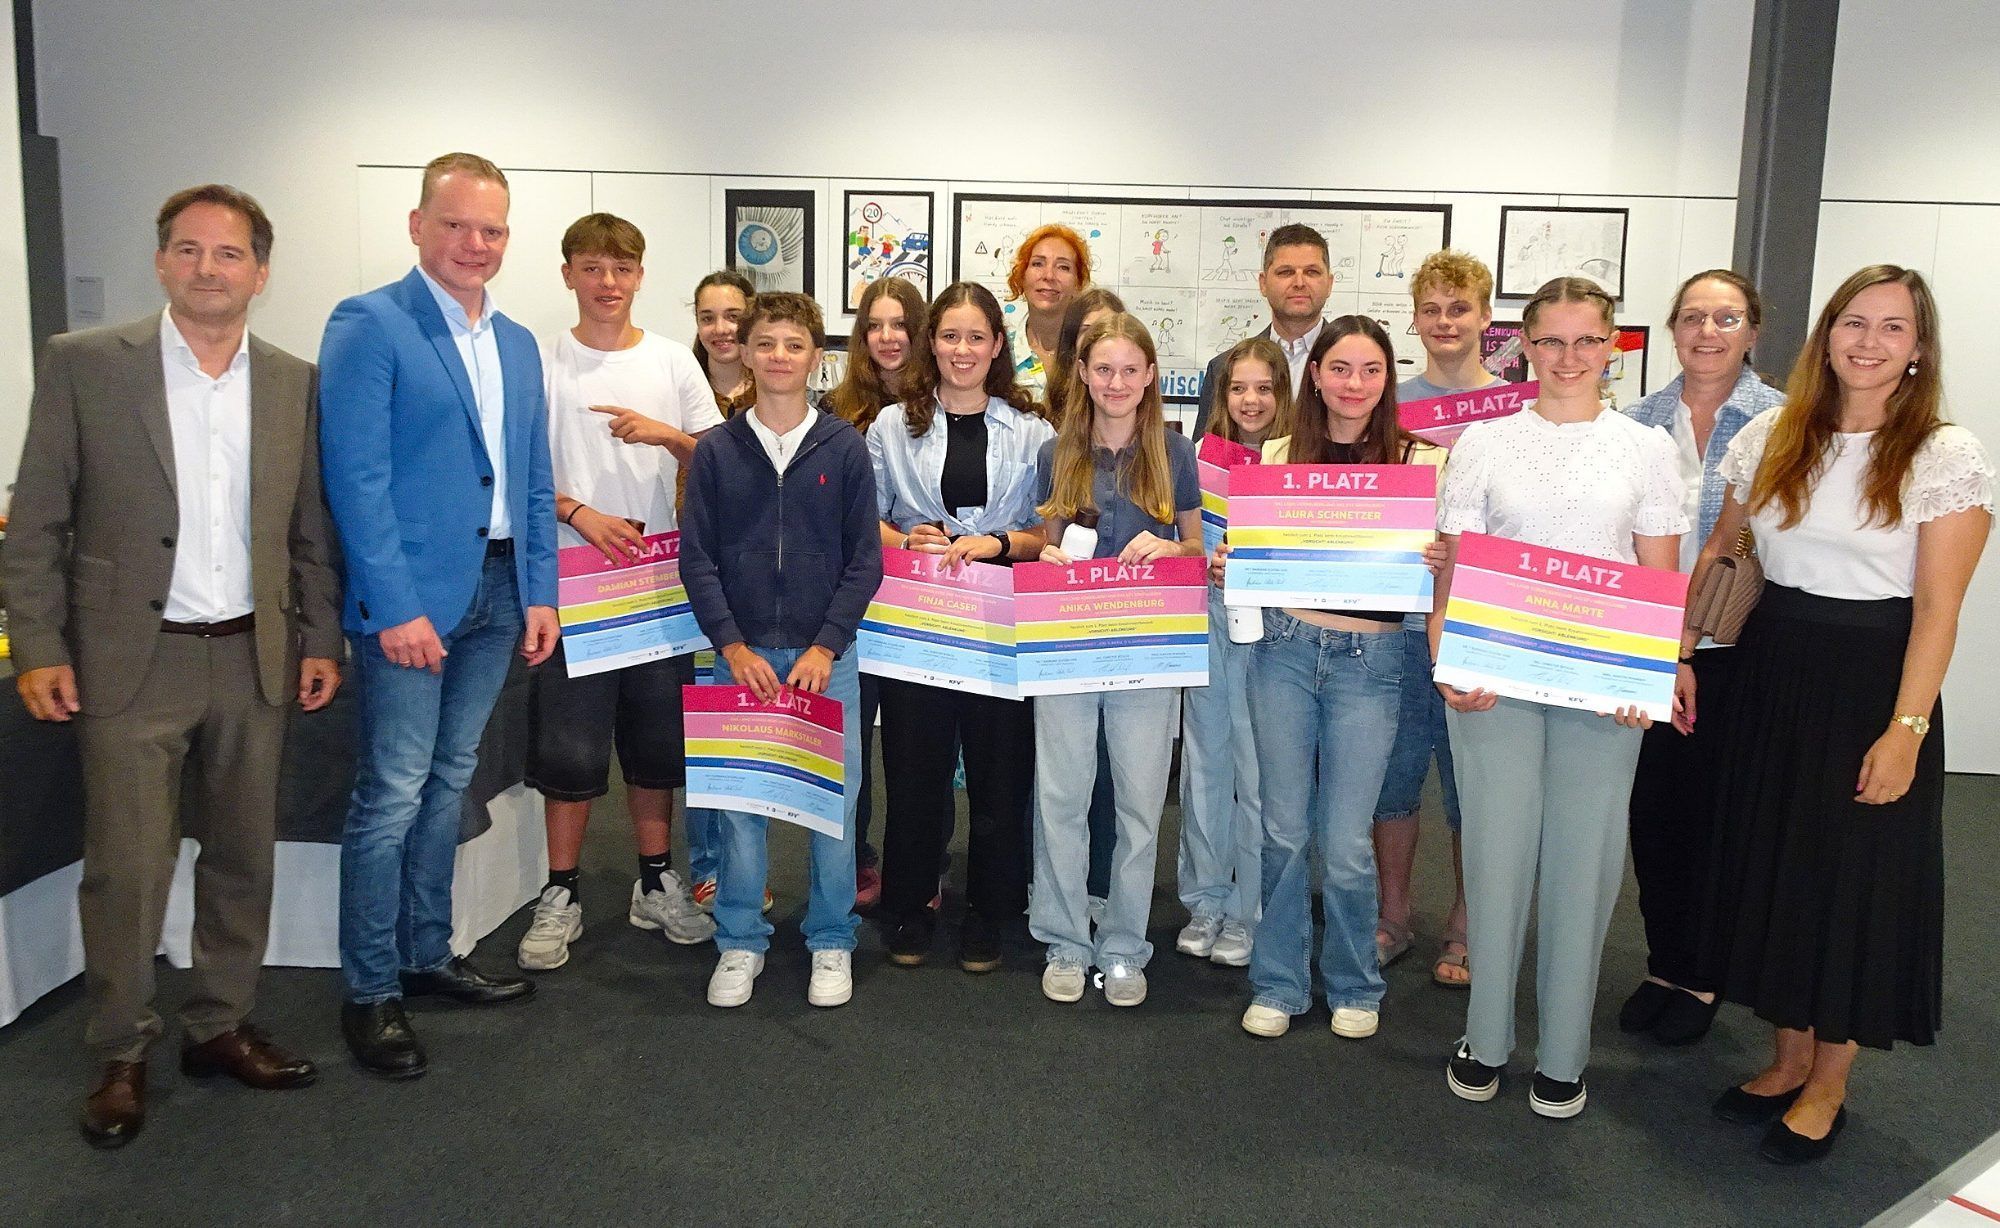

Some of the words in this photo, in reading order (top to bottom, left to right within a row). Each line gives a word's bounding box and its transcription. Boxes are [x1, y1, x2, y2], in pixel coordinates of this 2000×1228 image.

[866, 208, 879, 218] 20
[1433, 405, 1451, 421] 1.
[1456, 392, 1521, 417] PLATZ
[1283, 473, 1301, 489] 1.
[1308, 472, 1379, 490] PLATZ
[1278, 510, 1315, 519] LAURA
[1317, 510, 1381, 521] SCHNETZER
[910, 559, 926, 576] 1.
[1066, 569, 1084, 585] 1.
[1090, 564, 1155, 583] PLATZ
[1518, 552, 1537, 573] 1.
[1546, 557, 1623, 589] PLATZ
[598, 580, 637, 593] DAMIAN
[918, 594, 944, 607] FINJA
[946, 600, 977, 613] CASER
[1059, 603, 1092, 614] ANIKA
[1093, 599, 1165, 611] WENDENBURG
[1524, 594, 1560, 609] ANNA
[1560, 600, 1605, 619] MARTE
[737, 692, 755, 707] 1.
[763, 691, 812, 715] LATZ
[722, 724, 773, 734] NIKOLAUS
[775, 727, 822, 746] MARKSTALER
